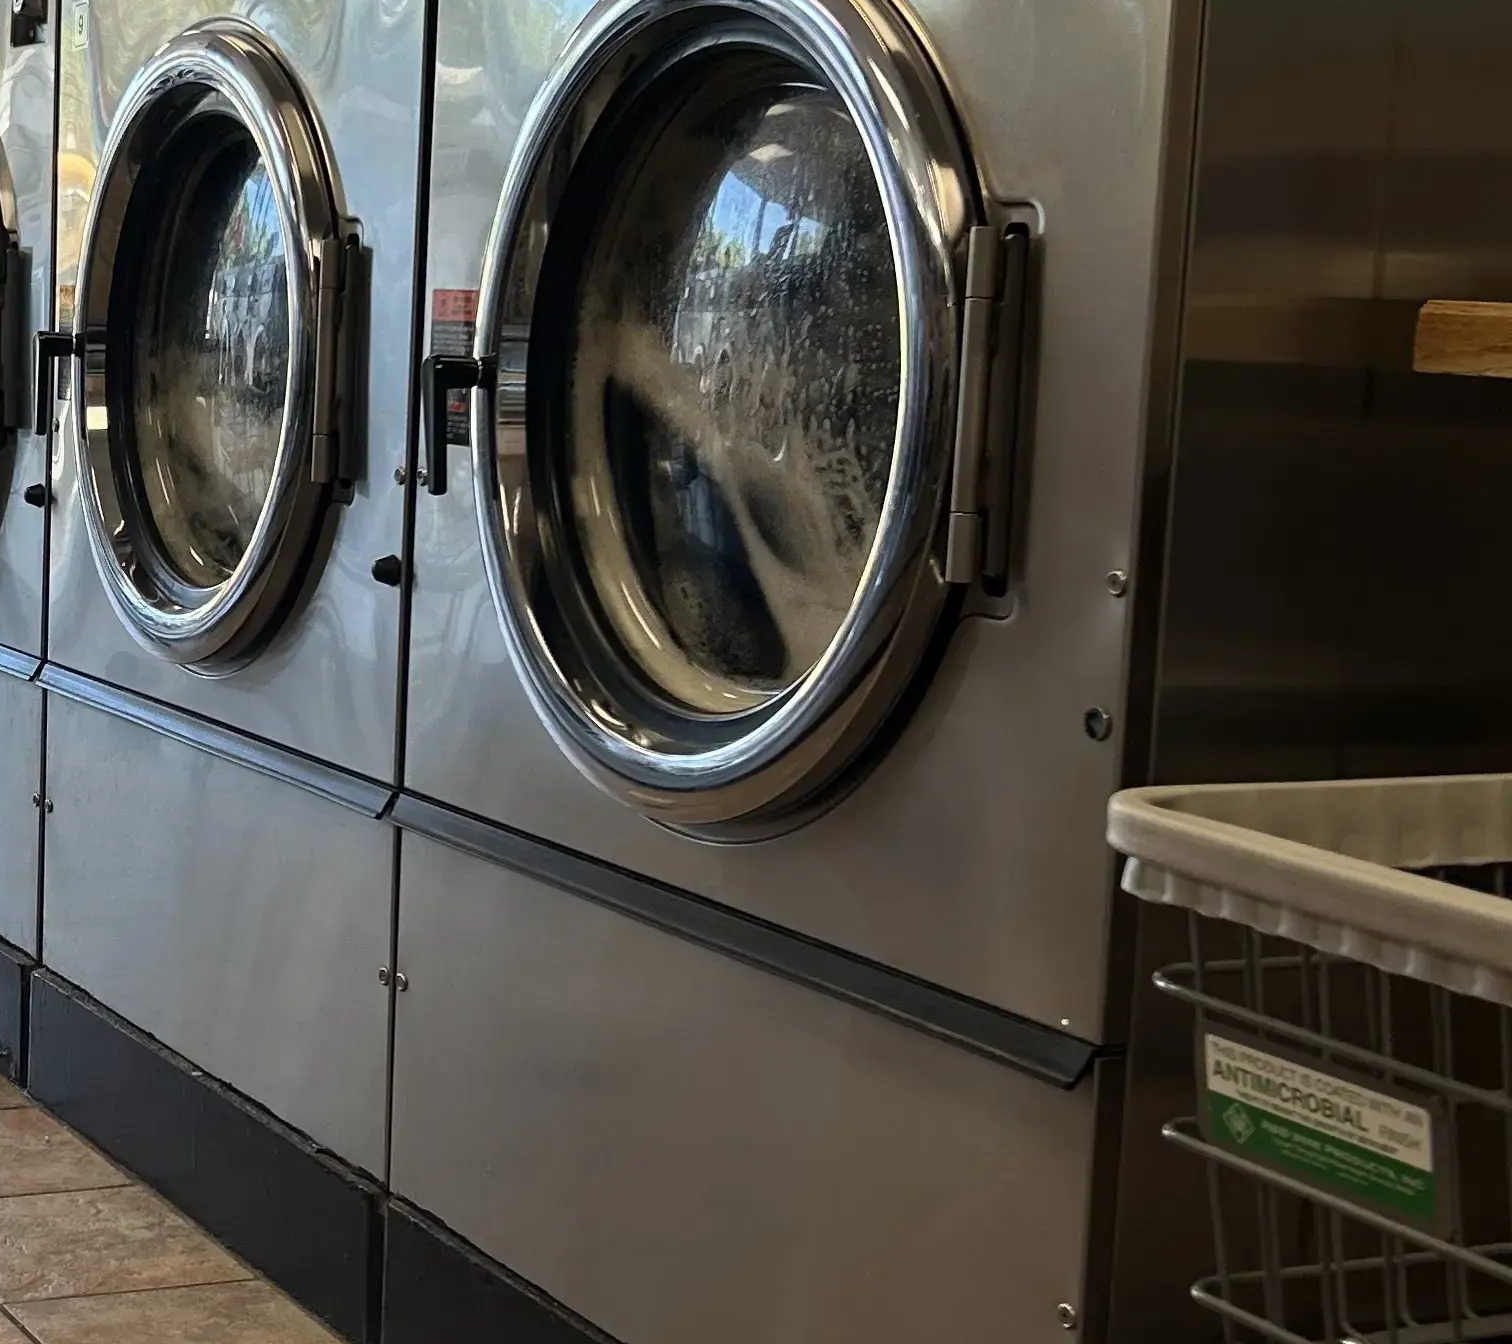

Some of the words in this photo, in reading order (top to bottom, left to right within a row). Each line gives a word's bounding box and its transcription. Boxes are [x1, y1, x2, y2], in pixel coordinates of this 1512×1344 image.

[78, 14, 84, 36] 9
[1213, 1059, 1370, 1133] ANTIMICROBIAL
[1378, 1123, 1423, 1151] FINISH
[1240, 1051, 1297, 1081] PRODUCT
[1313, 1077, 1368, 1108] COATED
